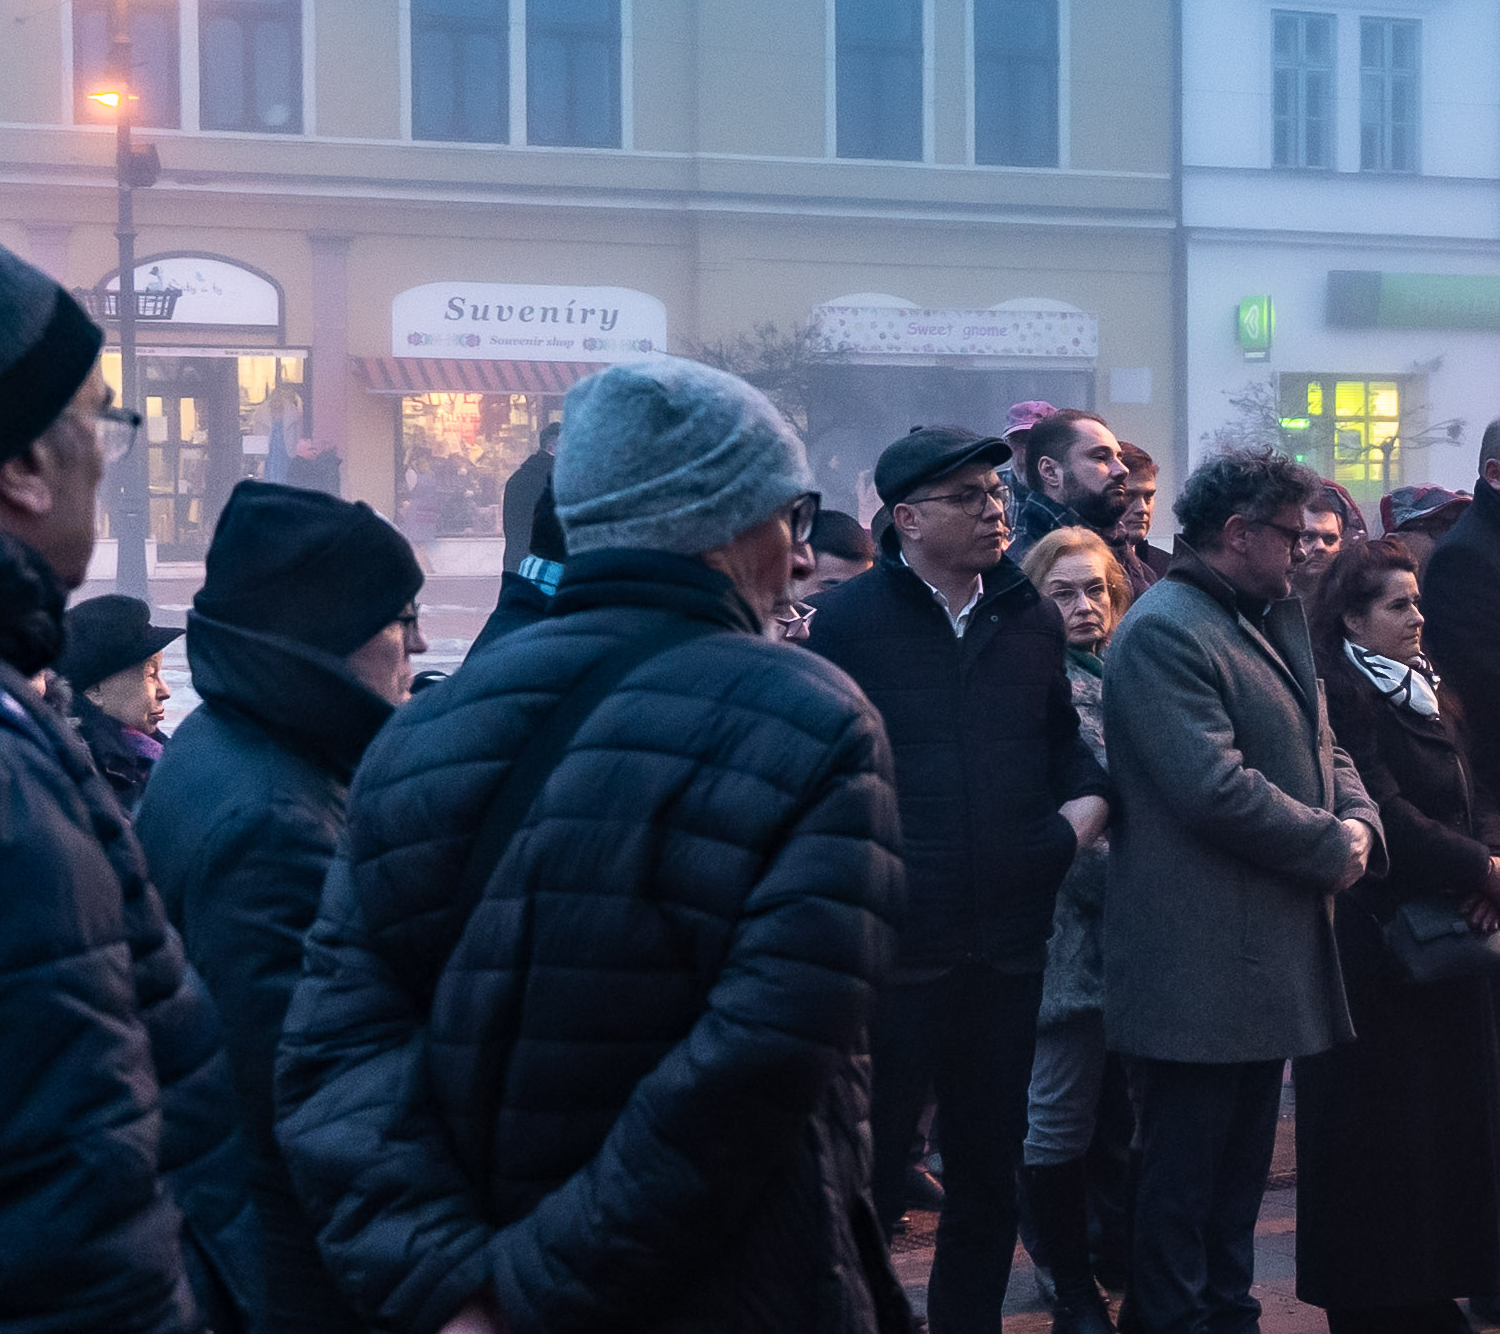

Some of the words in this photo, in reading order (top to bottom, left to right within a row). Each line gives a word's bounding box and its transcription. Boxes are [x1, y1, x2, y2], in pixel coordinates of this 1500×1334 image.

[444, 295, 620, 332] Suveníry
[907, 321, 953, 336] Sweet
[963, 325, 1009, 340] gnome
[489, 335, 544, 348] Souvenir
[546, 337, 575, 350] shop
